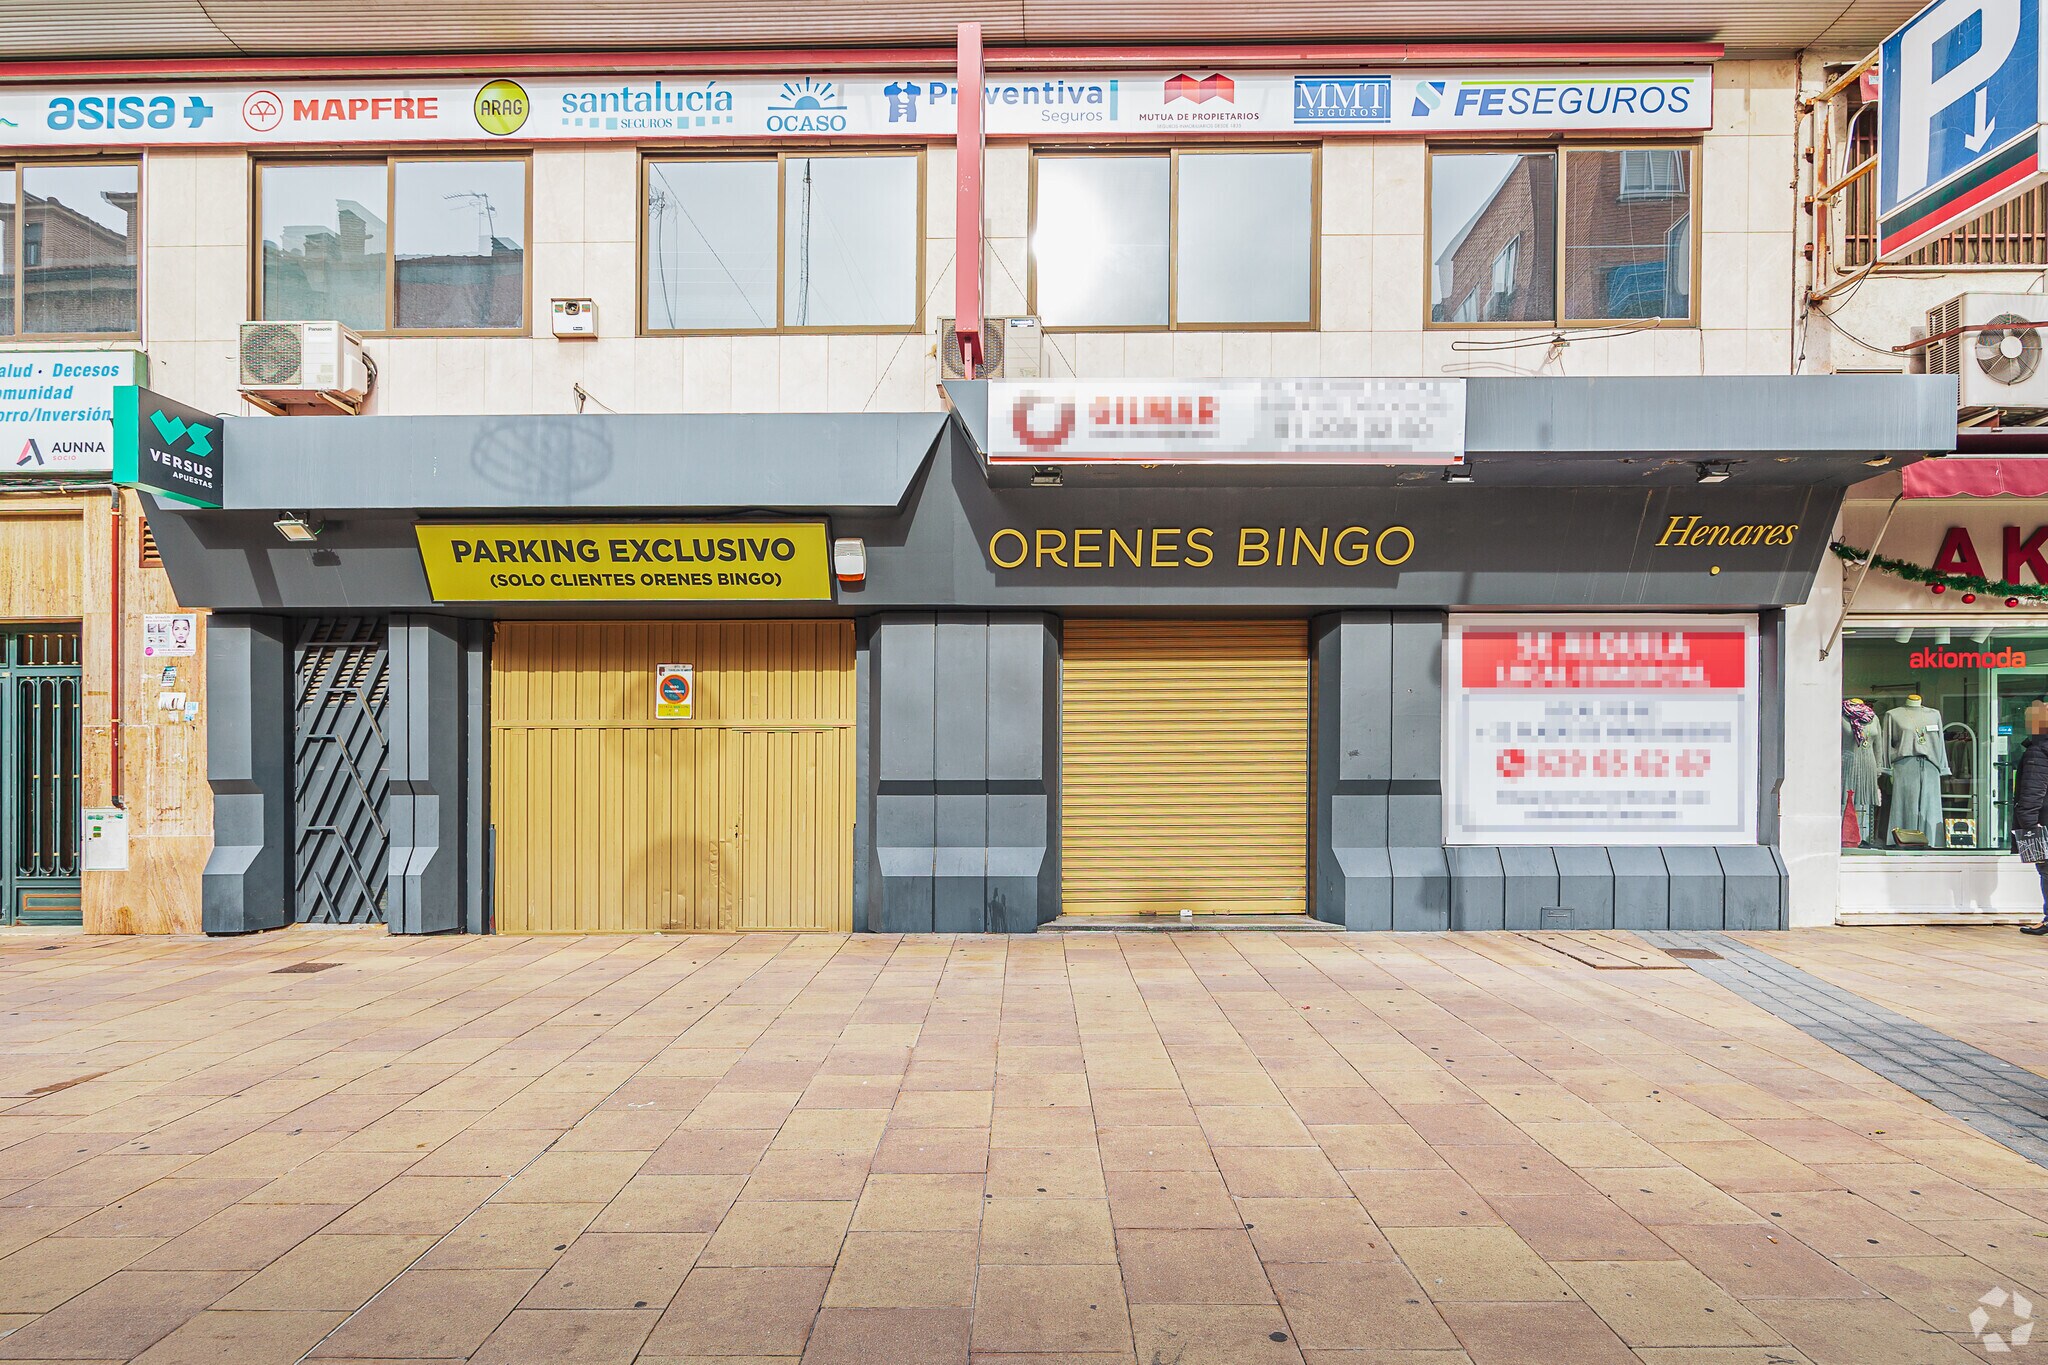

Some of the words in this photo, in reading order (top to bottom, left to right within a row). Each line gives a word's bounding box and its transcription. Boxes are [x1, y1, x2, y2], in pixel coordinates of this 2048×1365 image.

[562, 80, 733, 113] santalucía
[929, 80, 1103, 105] Prventiva
[1297, 82, 1389, 109] MMT
[47, 96, 175, 130] asisa
[293, 97, 438, 121] MAPFRE
[481, 99, 522, 116] ARAG
[1041, 109, 1103, 124] Seguros
[1139, 113, 1174, 121] MUTUA
[1192, 112, 1260, 120] PROPIETARIOS
[1308, 108, 1378, 117] SEGUROS
[621, 118, 672, 129] SEGUROS
[766, 115, 847, 132] OCASO
[52, 363, 120, 378] Decesos
[0, 385, 74, 400] munidad
[51, 442, 106, 453] AUNNA
[150, 448, 214, 479] VERSUS
[172, 471, 213, 489] APUESTAS
[1654, 515, 1800, 547] Henares
[450, 539, 600, 563] PARKING
[610, 537, 796, 562] EXCLUSIVO
[989, 527, 1215, 569] ORENES
[1236, 525, 1416, 566] BINGO
[490, 574, 545, 588] (SOLO
[549, 573, 636, 586] CLIENTES
[640, 572, 713, 586] ORENES
[717, 572, 782, 587] BINGO)
[1909, 646, 2027, 668] akiomoda
